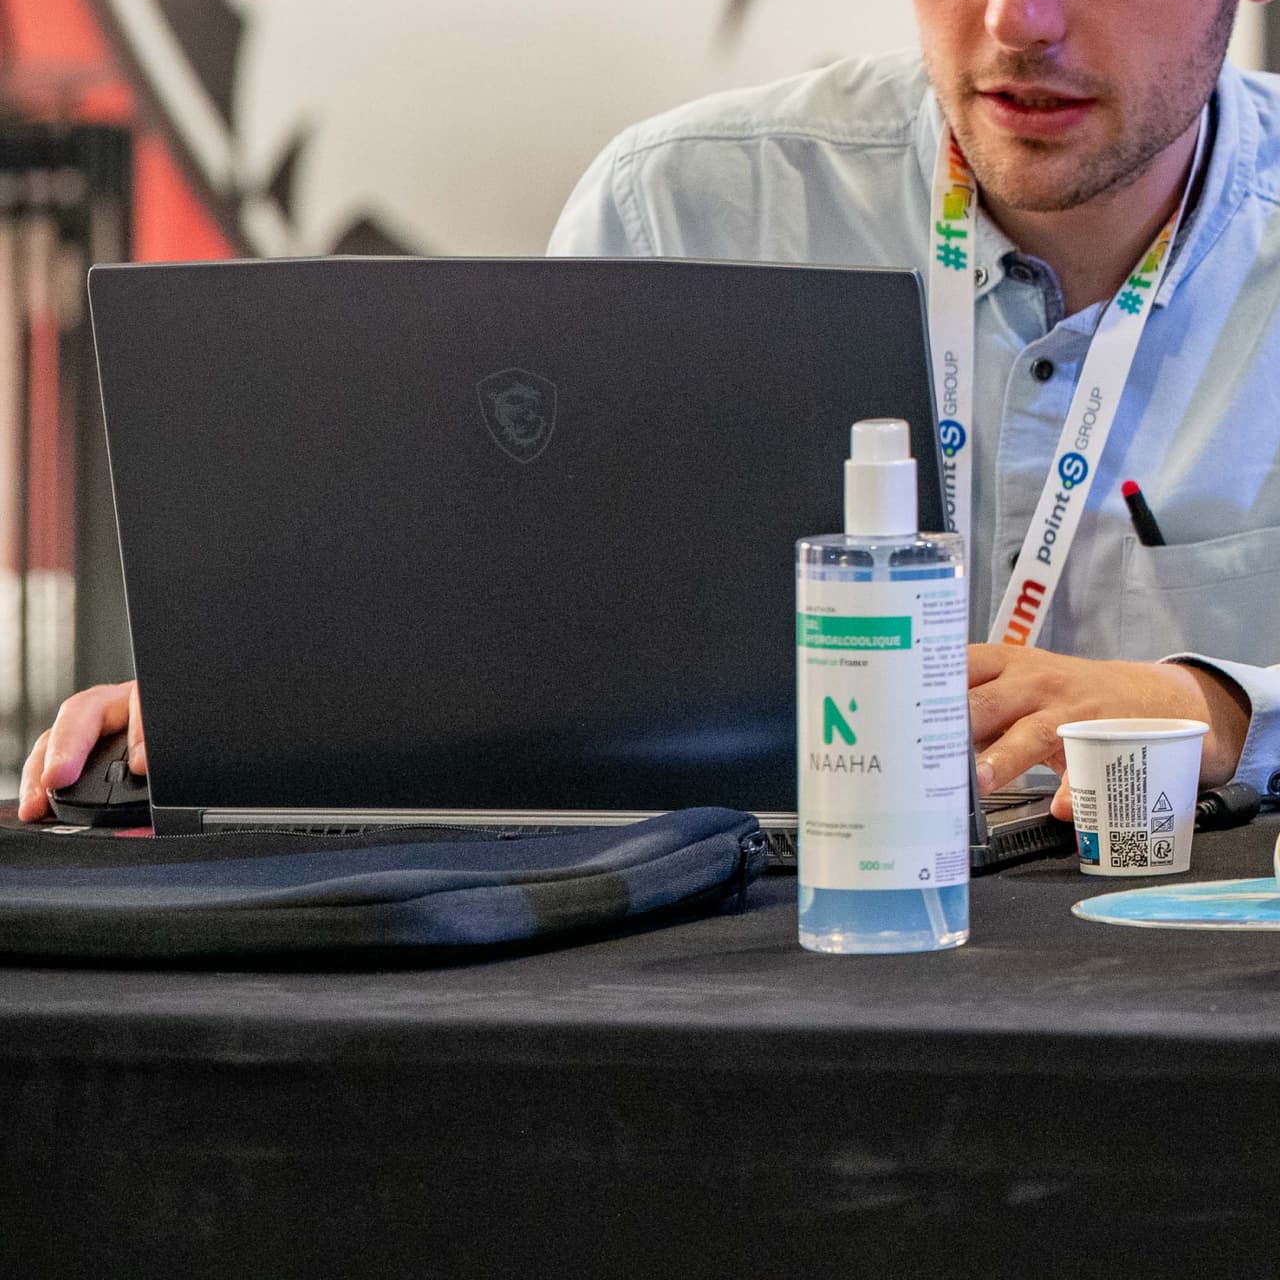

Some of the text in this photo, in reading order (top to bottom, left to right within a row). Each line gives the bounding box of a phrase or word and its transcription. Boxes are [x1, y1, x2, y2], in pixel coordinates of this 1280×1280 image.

[943, 351, 959, 417] GROUP
[1037, 491, 1071, 566] point
[1075, 386, 1103, 451] GROUP
[810, 752, 883, 774] NAAHA
